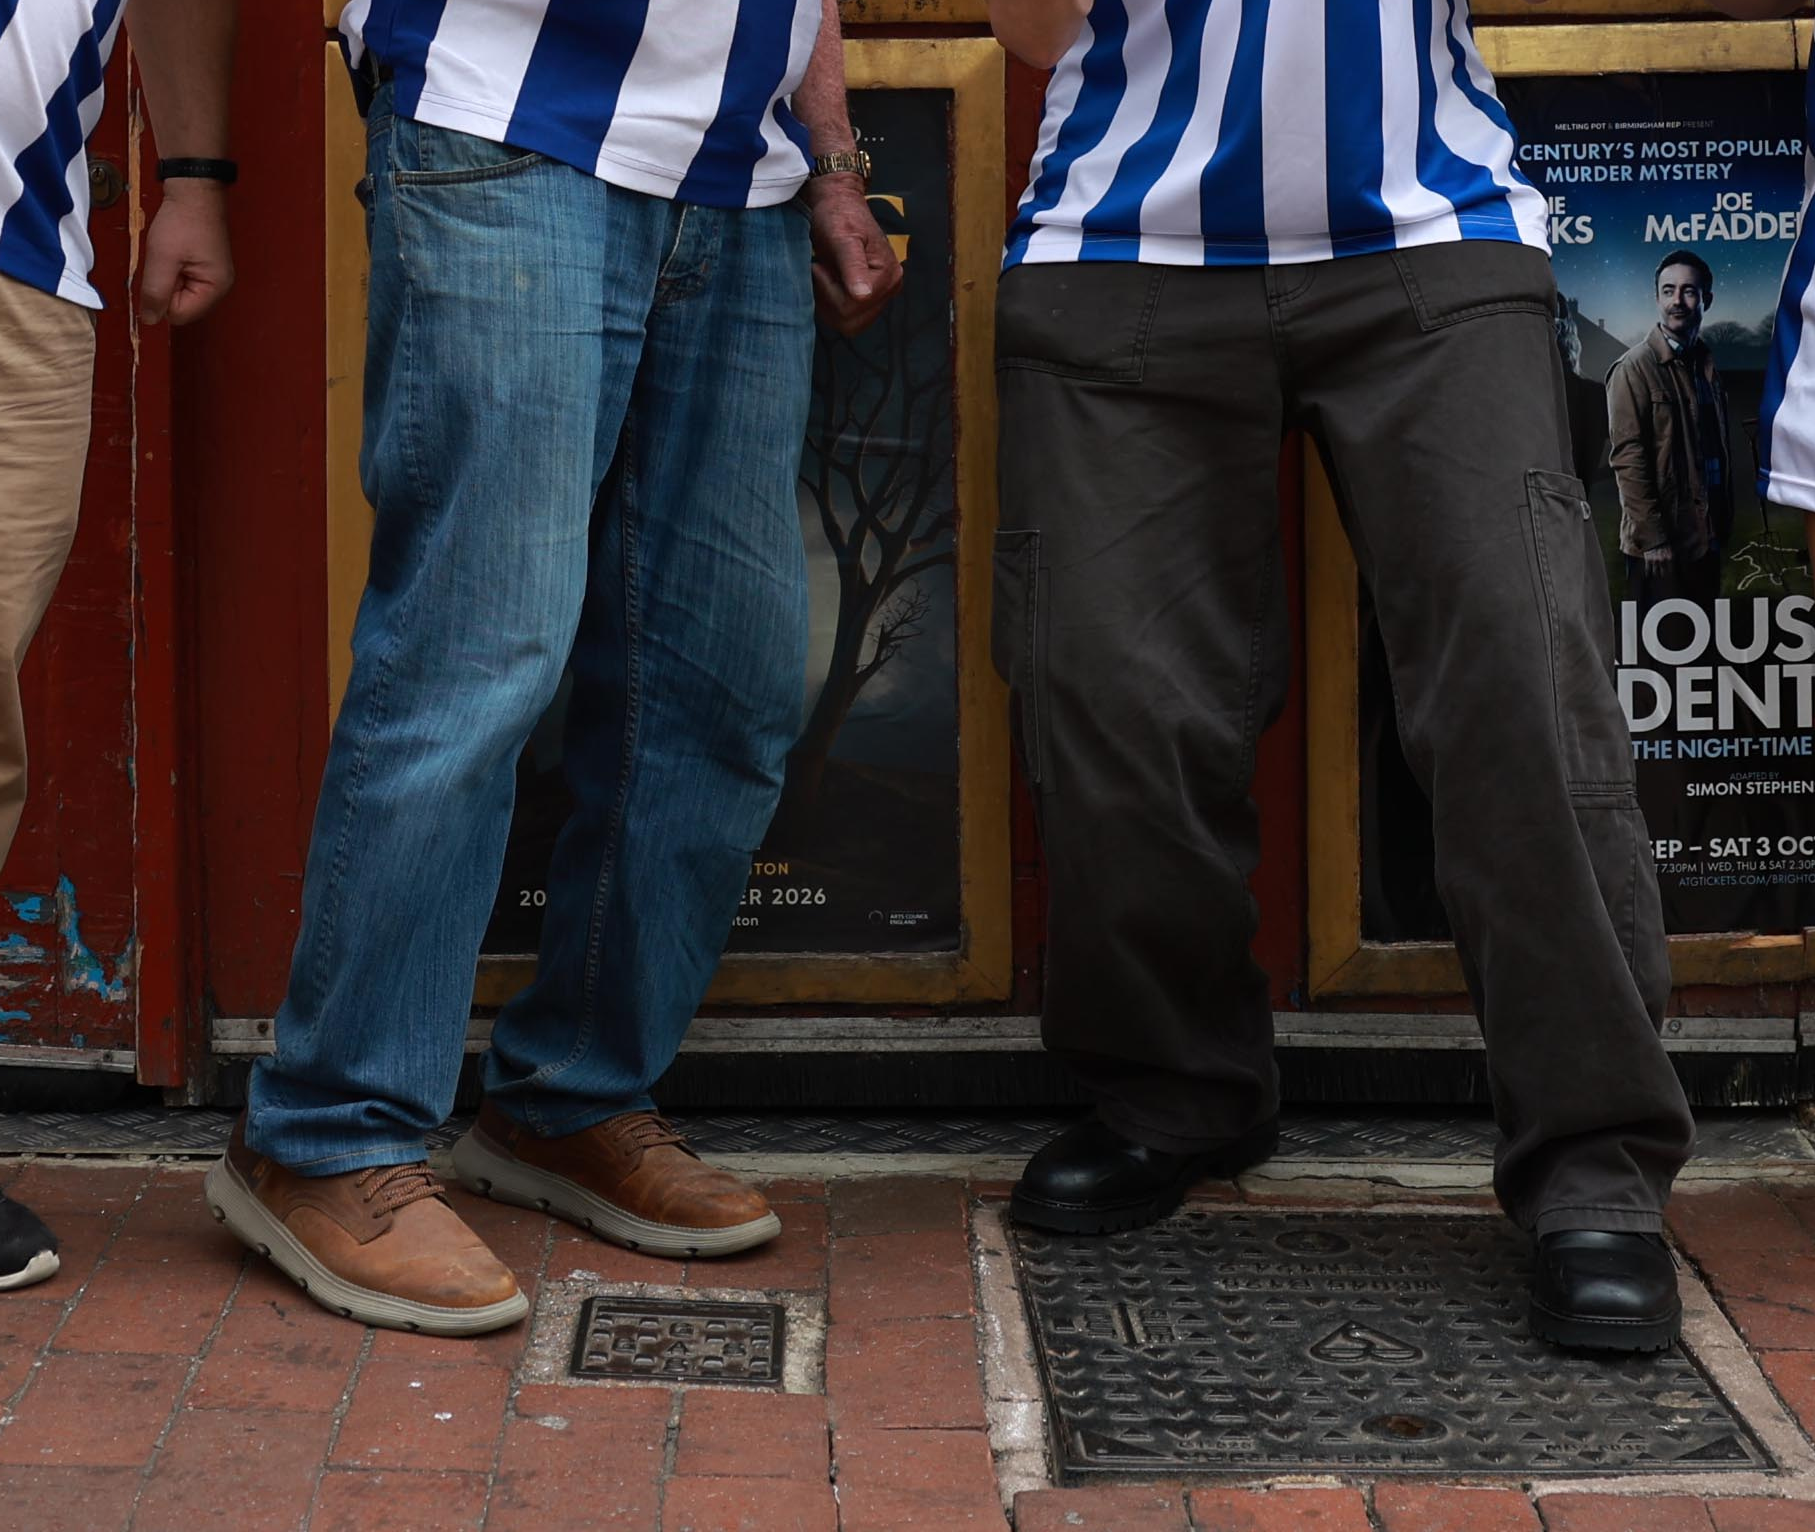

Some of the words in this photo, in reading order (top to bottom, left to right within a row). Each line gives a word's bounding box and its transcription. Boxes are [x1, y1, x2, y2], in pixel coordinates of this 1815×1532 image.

[1554, 122, 1589, 131] MELTING
[1590, 122, 1607, 131] POT
[1614, 121, 1665, 130] BIRMINGHAM
[1666, 121, 1682, 129] REP
[1641, 141, 1700, 159] MOST
[1706, 139, 1803, 157] POPULAR
[1545, 165, 1633, 183] MURDER
[1639, 163, 1733, 181] MYSTERY
[1712, 192, 1753, 212] JOE
[1644, 211, 1802, 243] McFADDE
[1632, 740, 1672, 760] THE
[1677, 736, 1813, 759] NIGHT-TIME
[1729, 772, 1767, 781] ADAPTED
[1768, 771, 1780, 780] BY
[1686, 782, 1742, 797] SIMON
[1709, 837, 1752, 858] SAT
[1755, 837, 1771, 856] 3
[1660, 863, 1697, 873] 7.30PM
[1707, 861, 1735, 873] WED,
[1736, 861, 1758, 872] THU
[1759, 862, 1767, 870] &
[1768, 860, 1786, 870] SAT
[519, 889, 547, 908] 20
[771, 887, 828, 906] 2026
